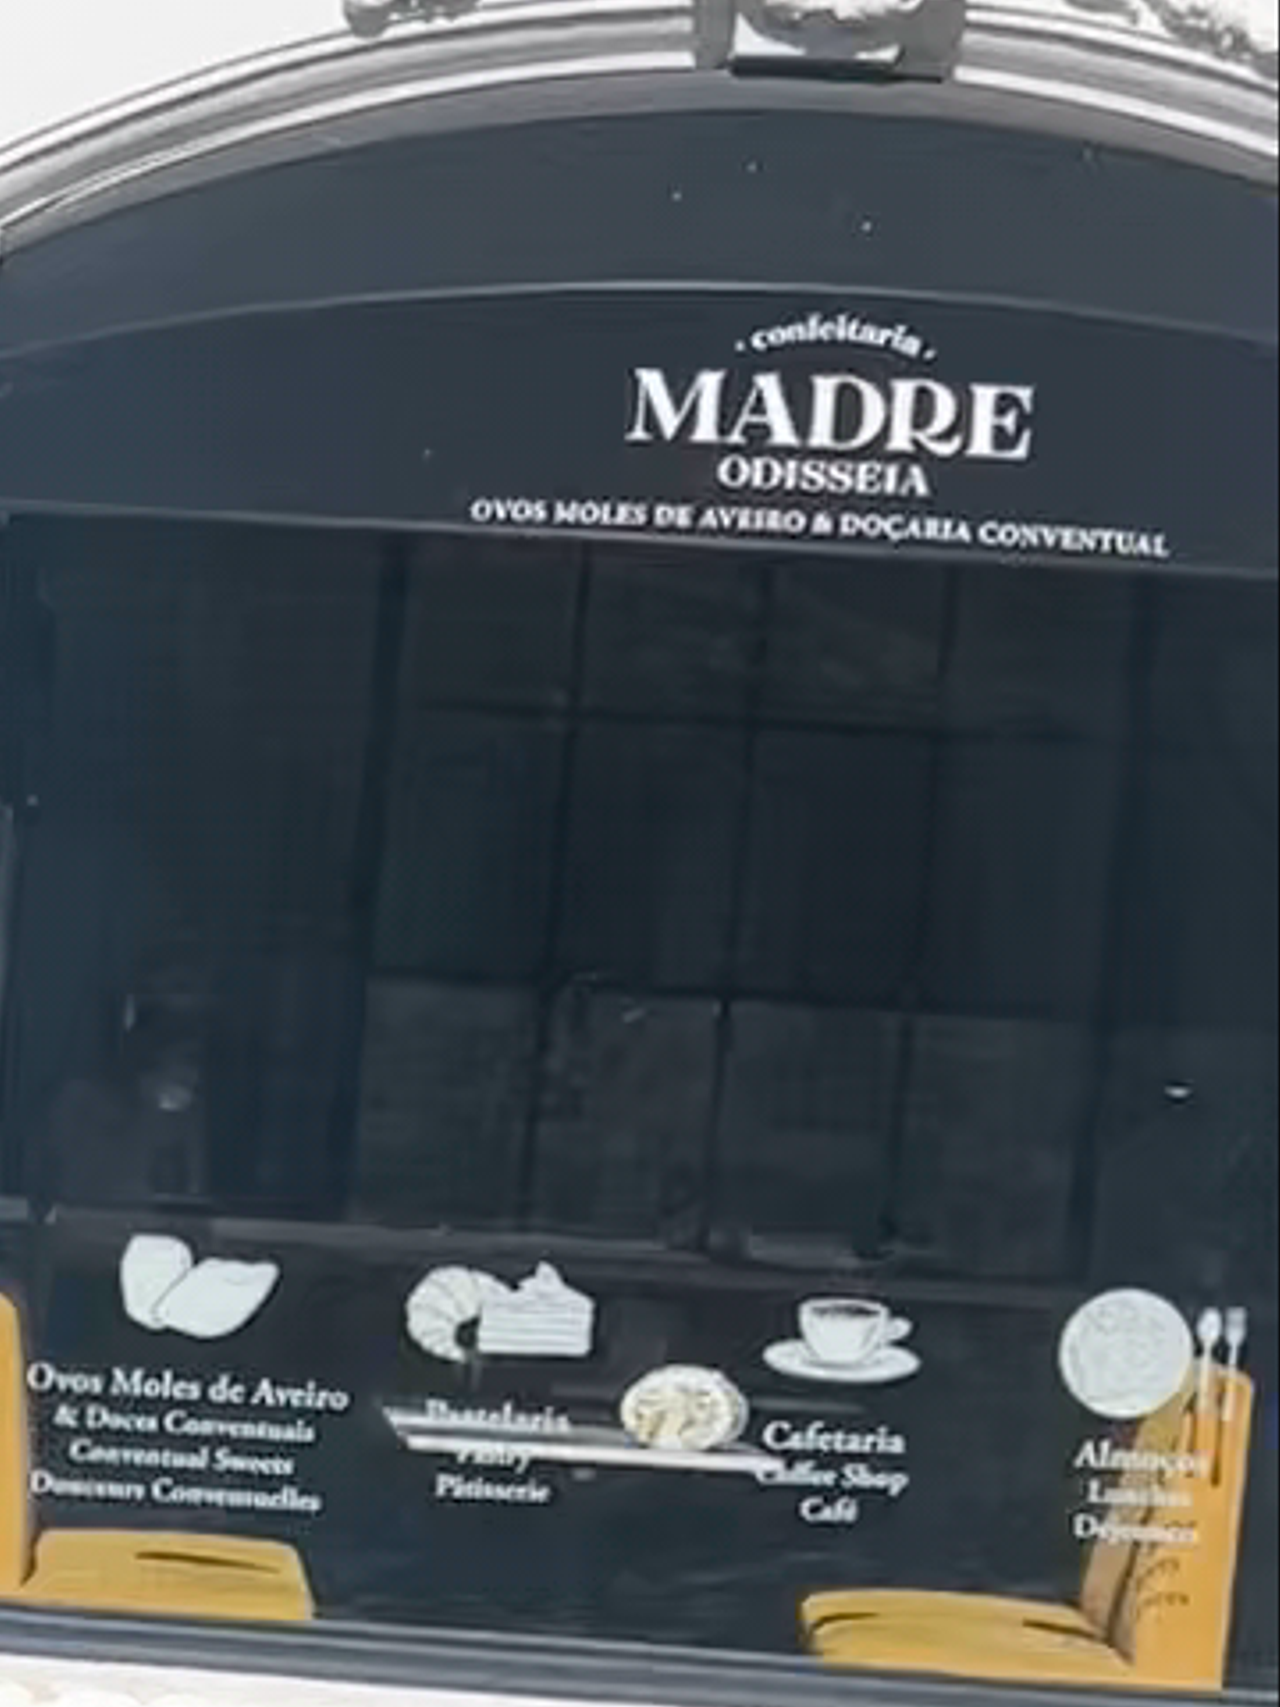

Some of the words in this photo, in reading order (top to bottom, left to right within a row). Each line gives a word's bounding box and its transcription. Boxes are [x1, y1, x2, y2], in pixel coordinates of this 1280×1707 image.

[751, 312, 923, 357] confeitaria
[625, 366, 1035, 460] MADRE
[716, 454, 930, 497] ODISSEIA
[470, 497, 548, 524] OVOS
[554, 499, 646, 526] MOLES
[653, 503, 692, 529] DE
[698, 505, 807, 534] AVEIRO
[810, 509, 833, 536] &
[839, 512, 971, 541] DOÇARIA
[977, 520, 1170, 559] CONVENTUAL
[26, 1361, 104, 1394] Ovos
[110, 1366, 201, 1402] Moles
[207, 1372, 245, 1404] de
[250, 1376, 350, 1411] Aveiro
[52, 1403, 79, 1428] &
[85, 1404, 158, 1432] Doces
[162, 1408, 316, 1443] Conventuais
[761, 1419, 906, 1455] Cafetaria
[68, 1438, 210, 1469] Conventual
[213, 1446, 294, 1476] Sweets
[840, 1461, 910, 1497] Shop
[799, 1495, 859, 1523] Café
